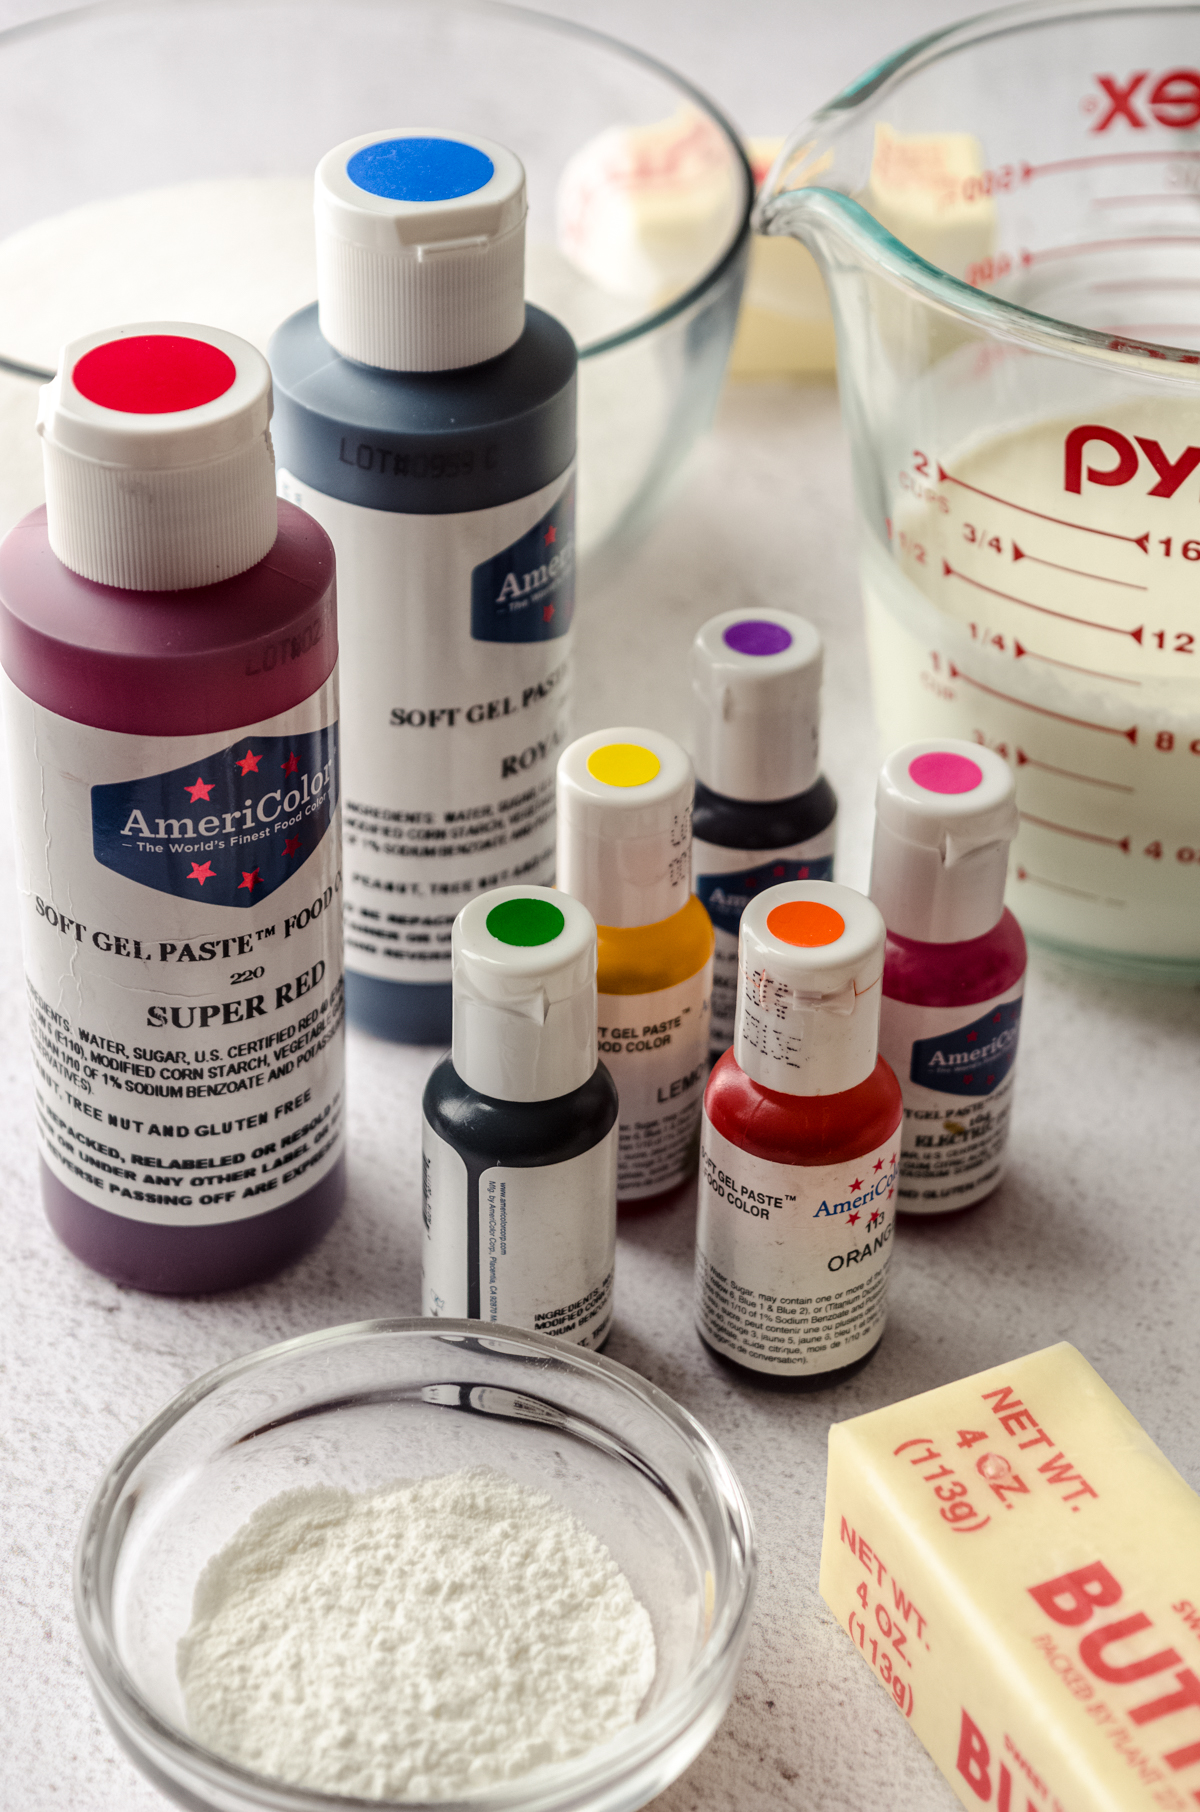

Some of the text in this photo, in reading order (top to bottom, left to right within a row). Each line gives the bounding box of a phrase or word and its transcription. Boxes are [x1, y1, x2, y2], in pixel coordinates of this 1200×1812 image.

[912, 450, 930, 478] 2
[1064, 423, 1200, 499] py
[962, 521, 1003, 555] 3/4
[1158, 536, 1200, 562] 16
[969, 621, 1006, 652] 1/4
[1151, 629, 1196, 655] 12
[389, 707, 461, 729] SOFT
[465, 697, 518, 725] GEL
[1155, 729, 1176, 755] 8
[119, 759, 332, 839] AmeriColor
[136, 792, 328, 854] The World’s Finest Food Color
[1143, 840, 1164, 862] 4
[35, 895, 87, 943] SOFT
[92, 931, 152, 962] GEL
[284, 886, 334, 940] FOOD
[230, 964, 267, 985] 220
[147, 1000, 269, 1029] SUPER
[275, 960, 327, 1010] RED
[78, 1027, 130, 1060] WATER,
[133, 1046, 191, 1067] SUGAR,
[194, 1050, 224, 1064] U.S.
[227, 1025, 297, 1059] CERTIFIED
[298, 1008, 319, 1033] RED
[90, 1049, 156, 1079] MODIFIED
[160, 1067, 204, 1081] CORN
[207, 1054, 271, 1079] STARCH,
[273, 1013, 332, 1062] VEGETABLE
[611, 1027, 639, 1040] GEL
[626, 1034, 672, 1053] COLOR
[84, 1060, 295, 1099] OF 1% SODIUM BENZOATE AND
[64, 1090, 103, 1122] TREE
[108, 1113, 144, 1134] NUT
[148, 1123, 190, 1138] AND
[194, 1111, 268, 1138] GLUTEN
[274, 1087, 312, 1120] FREE
[131, 1153, 246, 1170] RELABELED
[251, 1142, 277, 1159] OR
[280, 1103, 332, 1149] RESOLD
[78, 1149, 138, 1182] UNDER
[142, 1173, 184, 1188] ANY
[189, 1166, 257, 1188] OTHER
[261, 1142, 311, 1174] LABEL
[108, 1182, 193, 1207] PASSING
[199, 1190, 236, 1206] OFF
[242, 1177, 279, 1200] ARE
[717, 1170, 739, 1193] GEL
[499, 1182, 508, 1256] www.americolorcorp.com
[727, 1192, 770, 1221] COLOR
[865, 1211, 885, 1234] 113
[489, 1285, 498, 1295] CA
[730, 1280, 755, 1299] Sugar,
[758, 1293, 777, 1305] may
[780, 1296, 813, 1306] contain
[815, 1295, 833, 1304] one
[835, 1291, 844, 1301] or
[846, 1283, 865, 1297] more
[738, 1295, 757, 1309] Blue
[767, 1305, 774, 1313] &
[776, 1305, 797, 1315] Blue
[825, 1295, 861, 1314] (Titanium
[534, 1308, 584, 1332] MODIFIED
[731, 1301, 747, 1315] 1/10
[749, 1310, 757, 1318] of
[760, 1312, 773, 1323] 1%
[775, 1315, 809, 1325] Sodium
[811, 1308, 850, 1324] Benzoate
[744, 1319, 763, 1330] peut
[766, 1325, 801, 1335] contenir
[803, 1327, 820, 1335] une
[822, 1324, 833, 1332] ou
[761, 1332, 785, 1344] jaune
[797, 1336, 822, 1347] jaune
[807, 1345, 828, 1354] mois
[830, 1341, 841, 1350] de
[981, 1386, 1100, 1514] NET WT.
[892, 1437, 992, 1534] (113g)
[956, 1429, 1031, 1511] 4 OZ.
[840, 1514, 931, 1652] NET WT.
[856, 1581, 913, 1670] 4 OZ.
[1172, 1598, 1200, 1642] SW
[847, 1610, 914, 1719] (113g)
